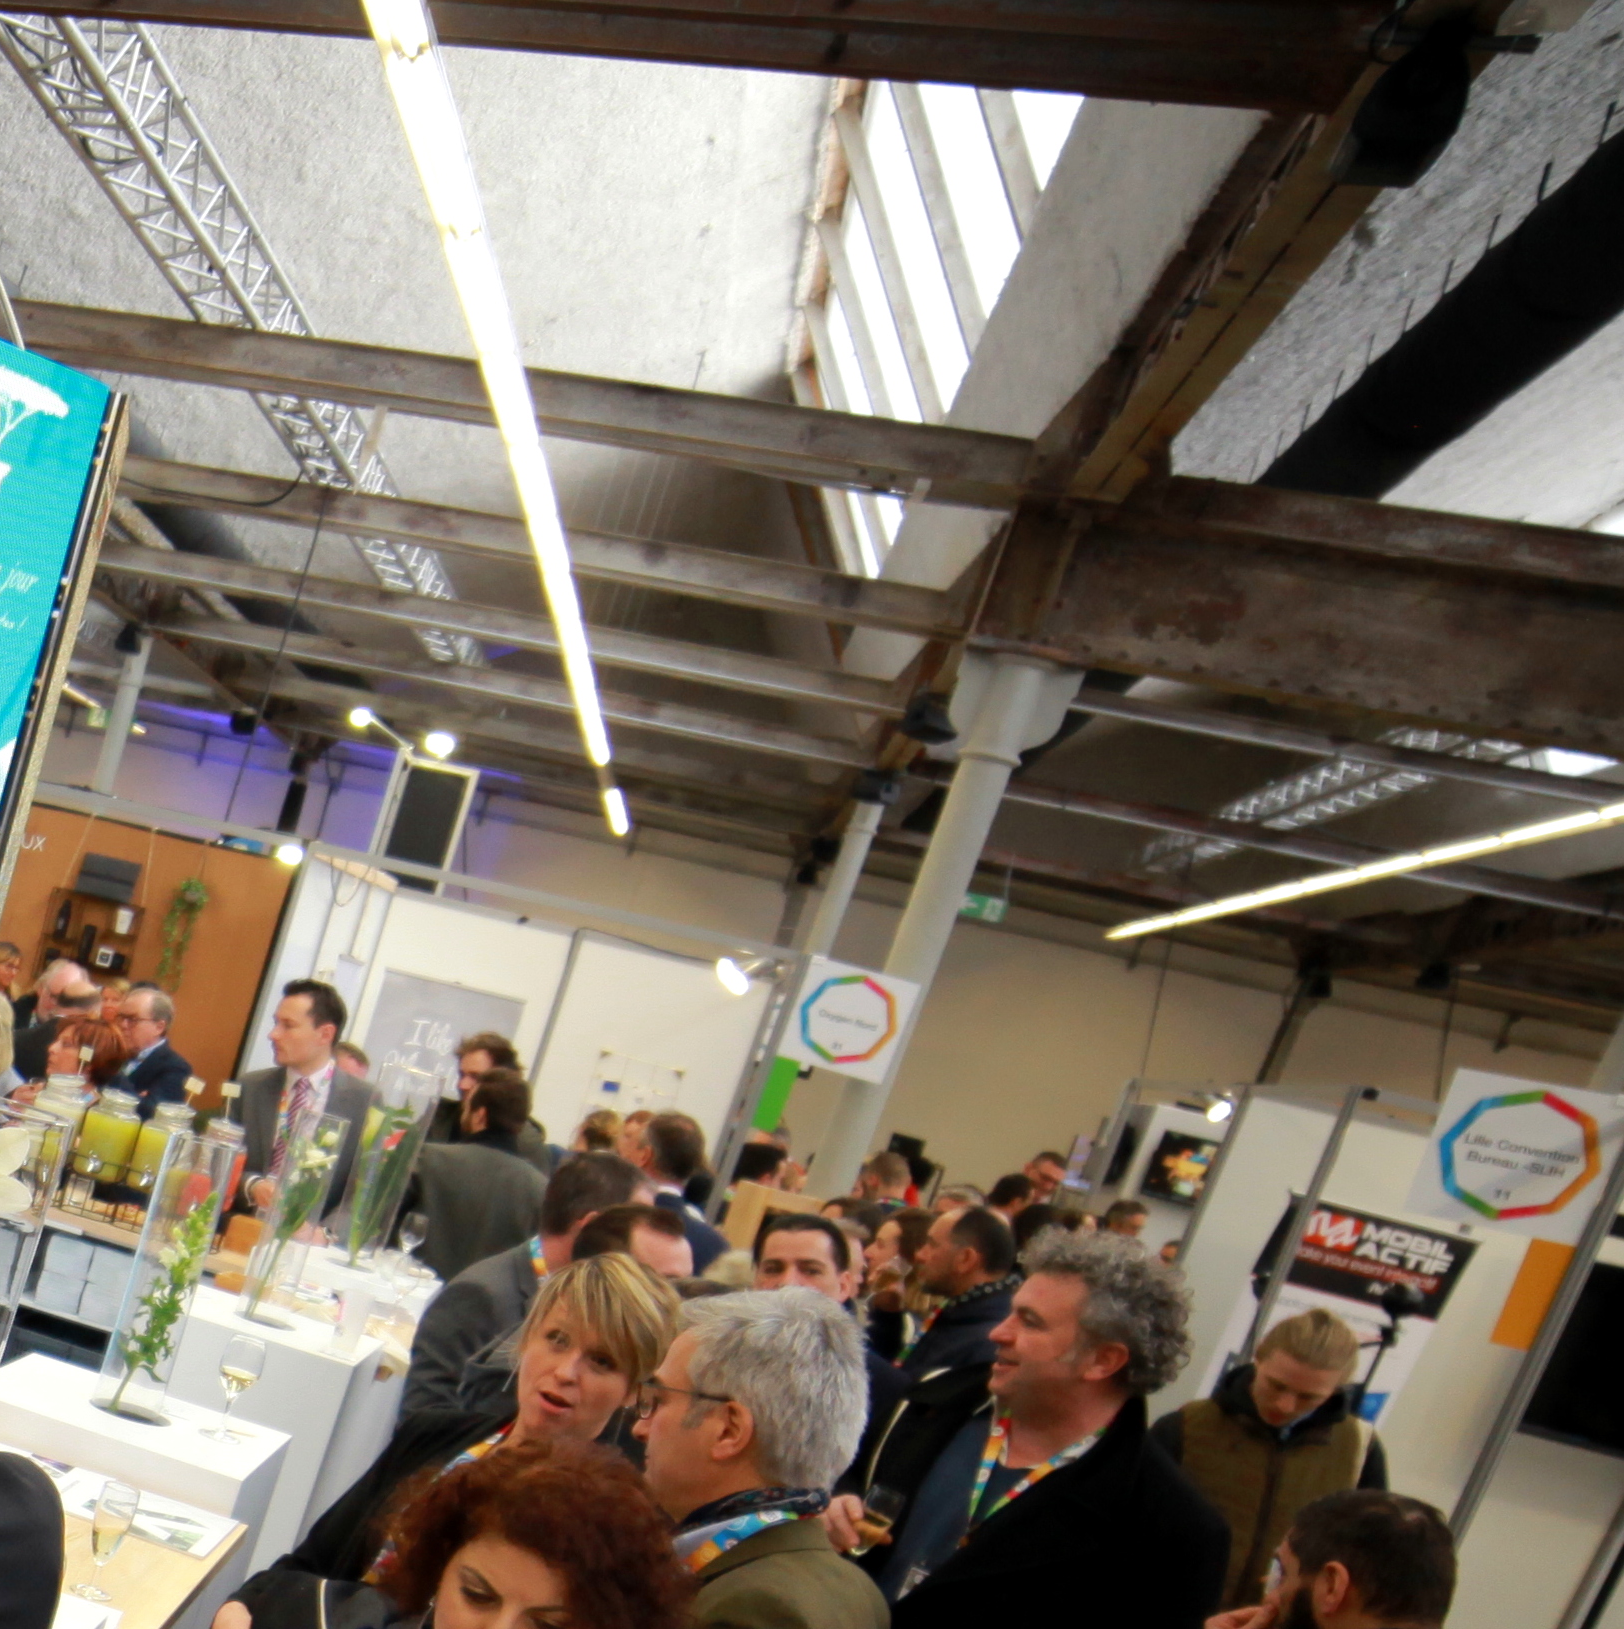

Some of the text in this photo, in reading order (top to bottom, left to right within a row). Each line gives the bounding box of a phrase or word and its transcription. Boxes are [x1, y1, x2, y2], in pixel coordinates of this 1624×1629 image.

[1464, 1133, 1580, 1165] Lille Convention
[1466, 1150, 1519, 1170] Bureau
[1363, 1221, 1455, 1262] MOBIL
[1354, 1242, 1451, 1277] ACTIF
